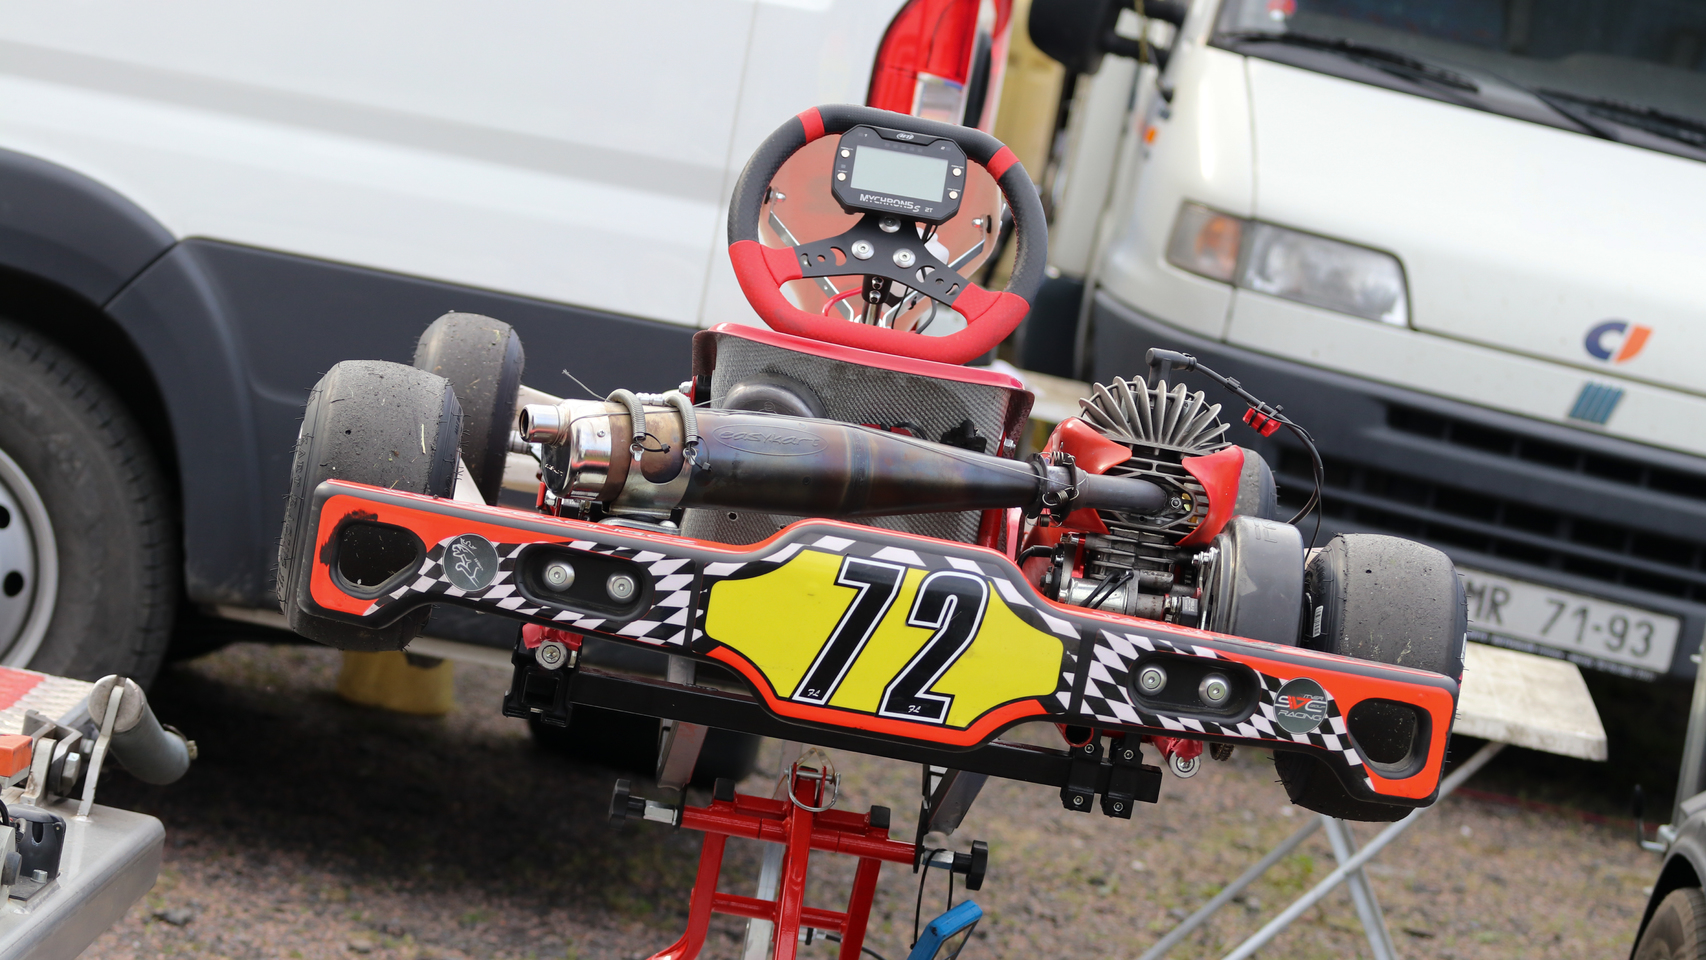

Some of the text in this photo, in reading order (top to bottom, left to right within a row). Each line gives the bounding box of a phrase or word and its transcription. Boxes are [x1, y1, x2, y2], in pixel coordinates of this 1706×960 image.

[791, 553, 991, 725] 72
[1539, 596, 1656, 659] 71-93
[1278, 709, 1322, 721] RACING
